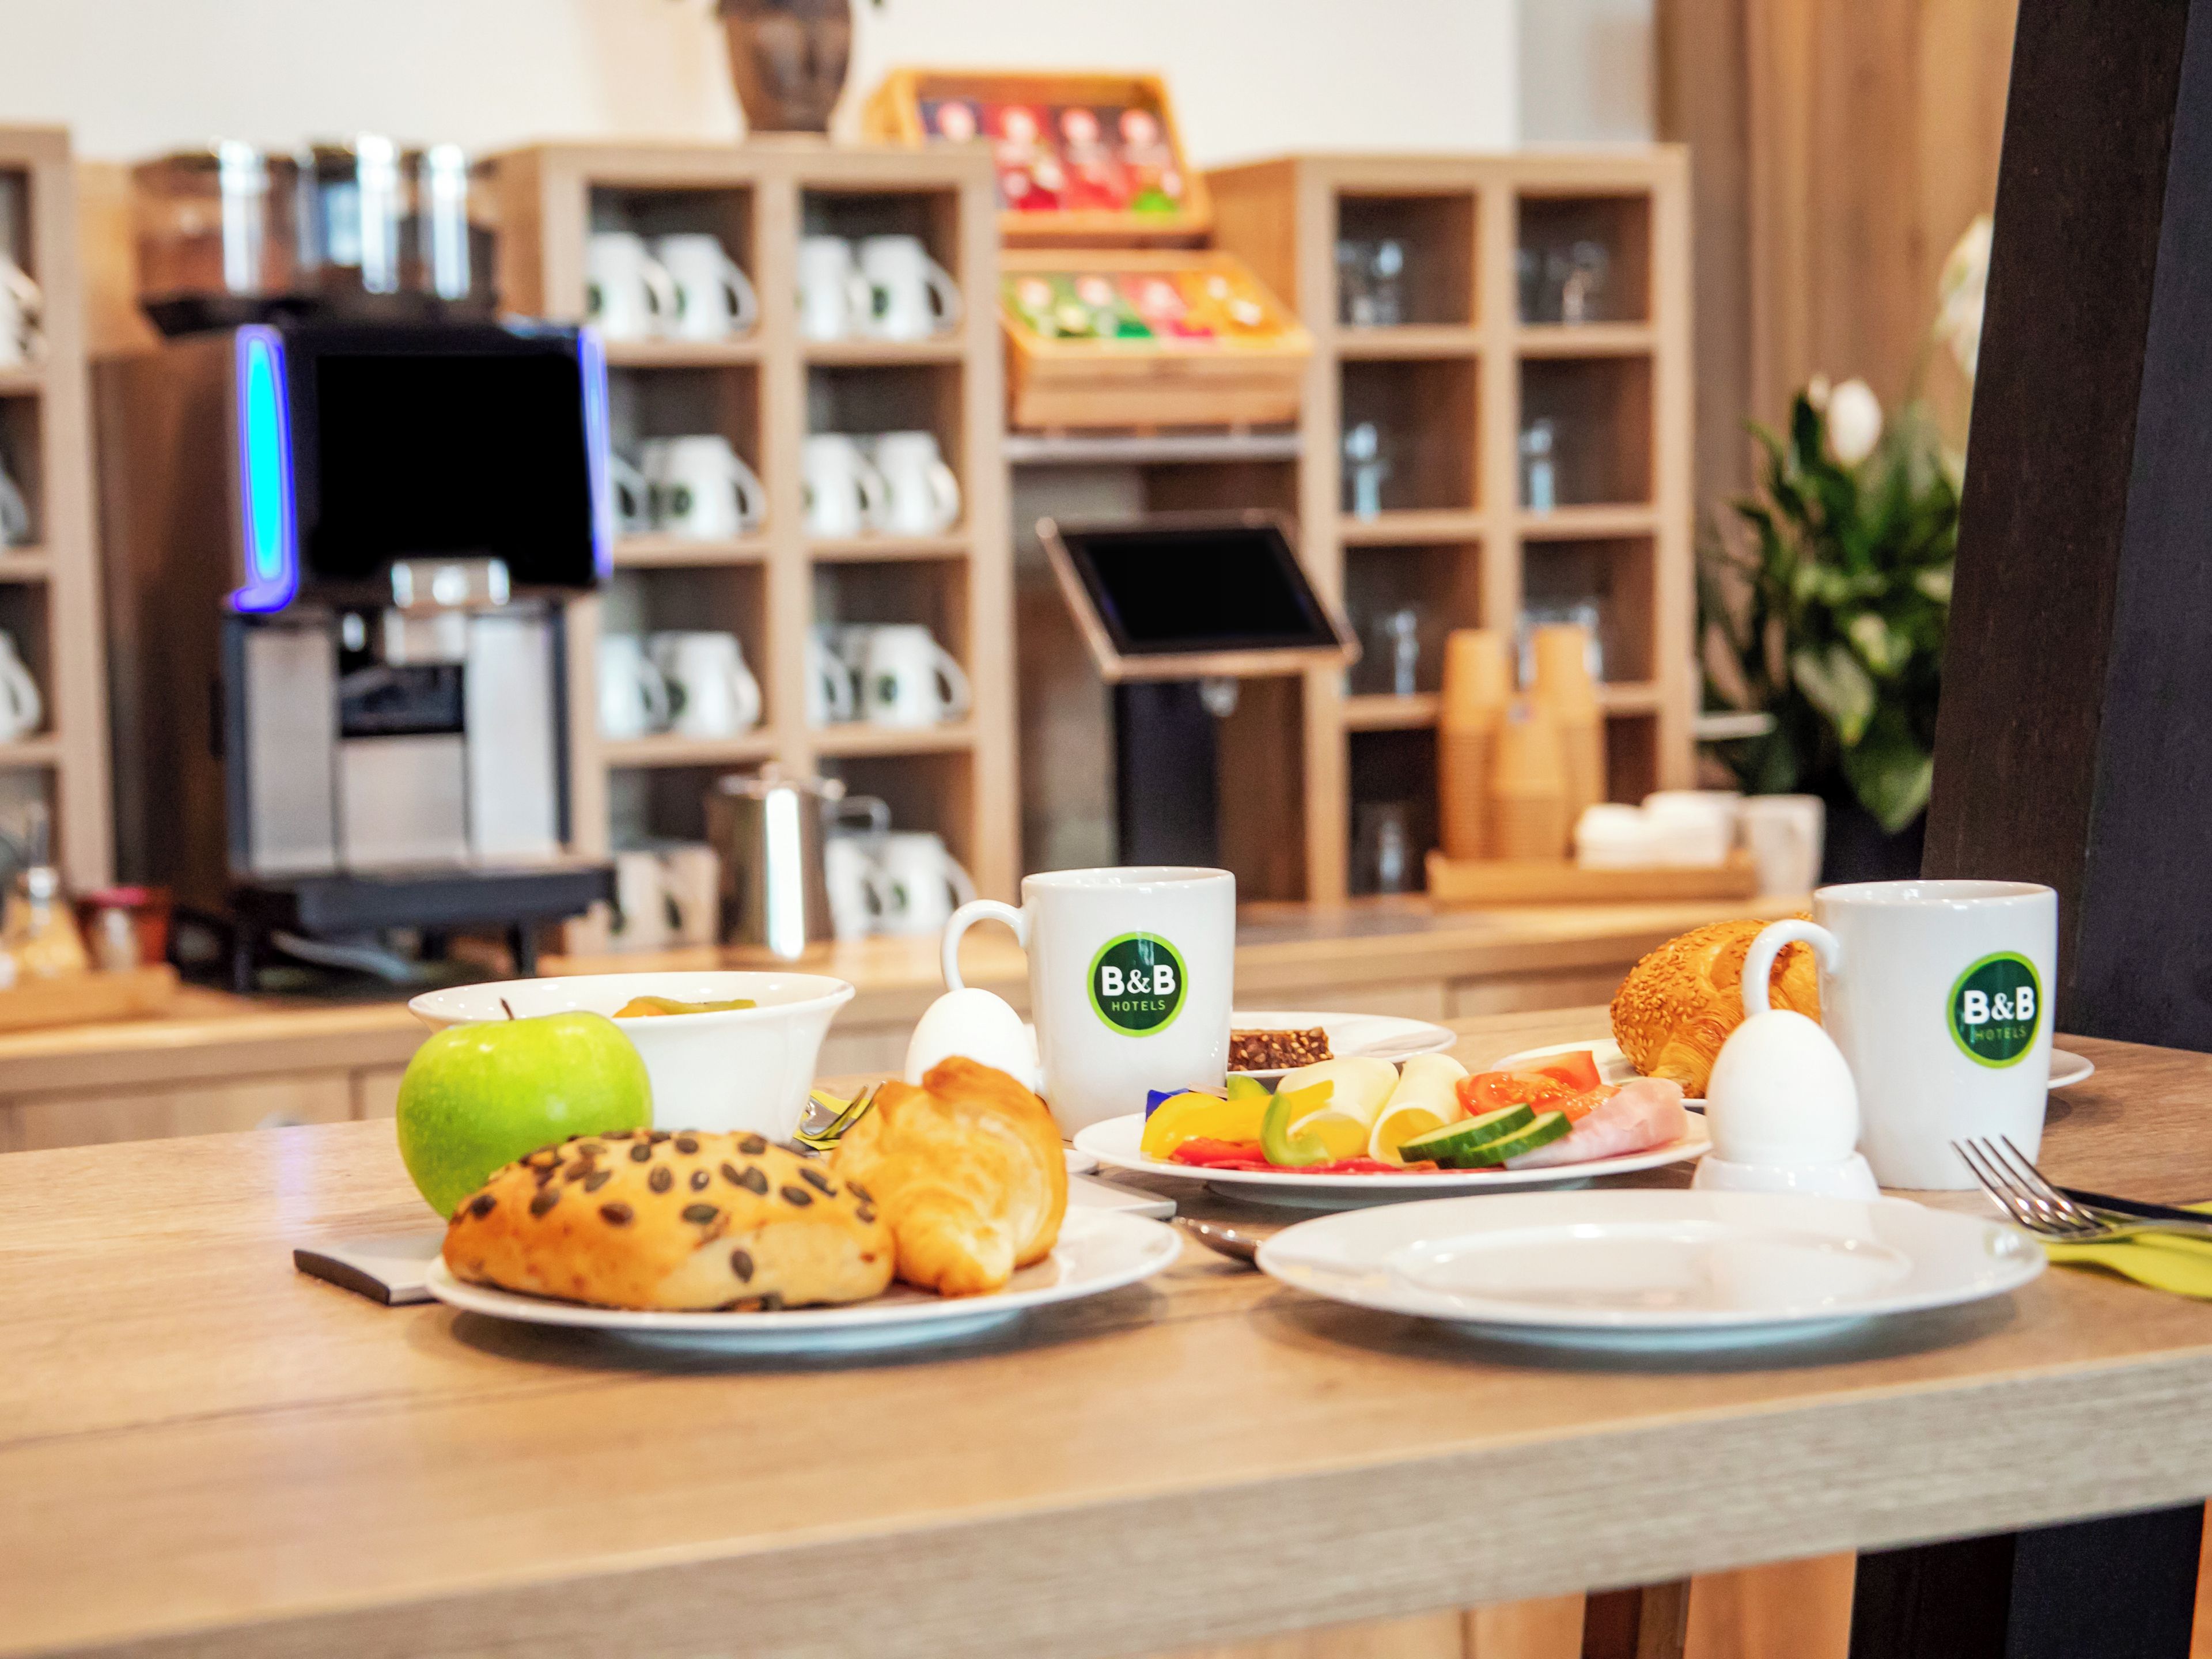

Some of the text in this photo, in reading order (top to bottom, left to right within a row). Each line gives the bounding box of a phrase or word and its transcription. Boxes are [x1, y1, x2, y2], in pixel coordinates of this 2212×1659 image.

[1101, 965, 1176, 996] B&B
[1112, 1000, 1166, 1012] HOTELS
[1964, 986, 2034, 1024] B&B
[1975, 1026, 2027, 1041] HOTELS
